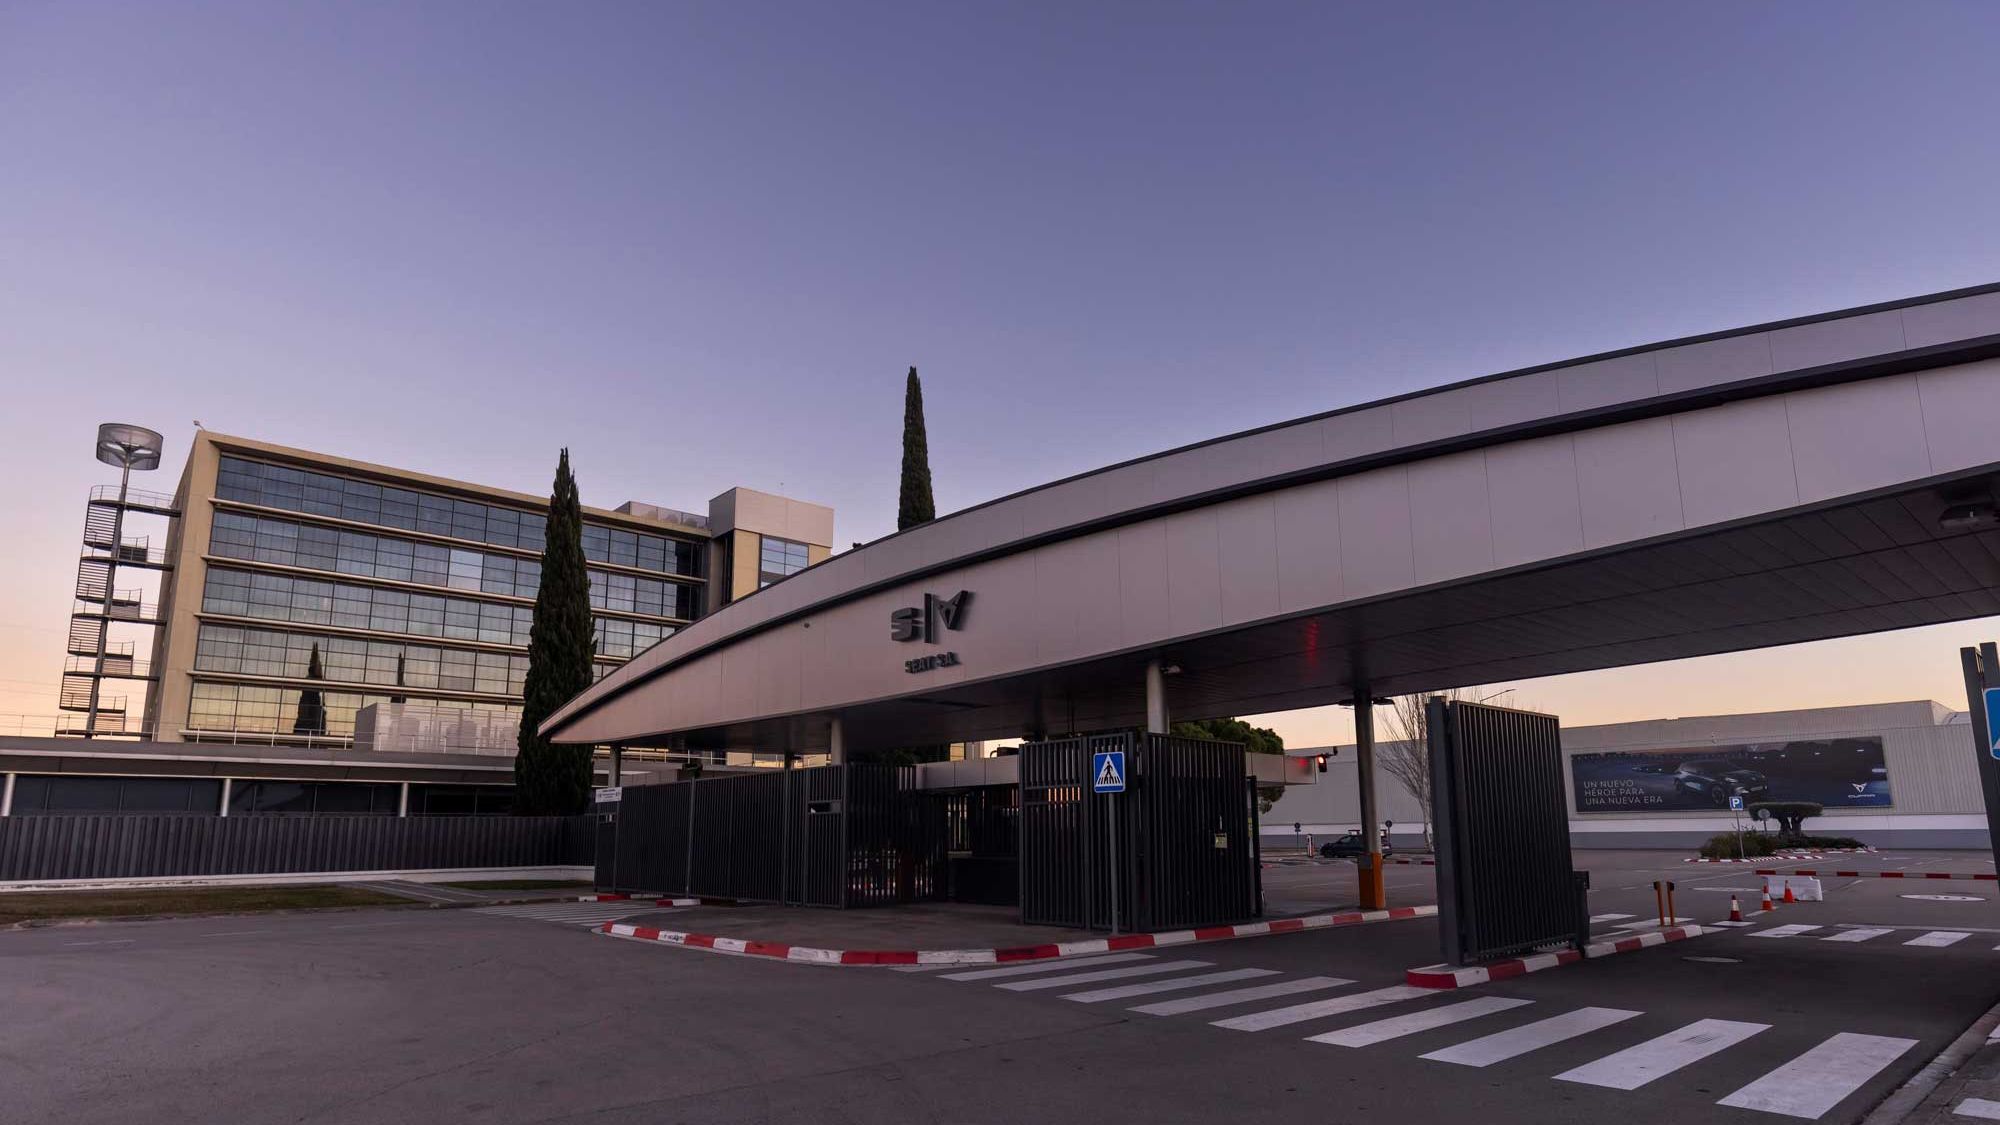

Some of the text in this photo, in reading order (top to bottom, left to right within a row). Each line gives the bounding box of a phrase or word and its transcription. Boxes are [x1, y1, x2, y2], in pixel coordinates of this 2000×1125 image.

[1583, 779, 1634, 788] UN NUEVO
[1620, 788, 1645, 796] PARA
[1585, 795, 1663, 805] UNA NUEVA ERA
[1732, 798, 1740, 808] P
